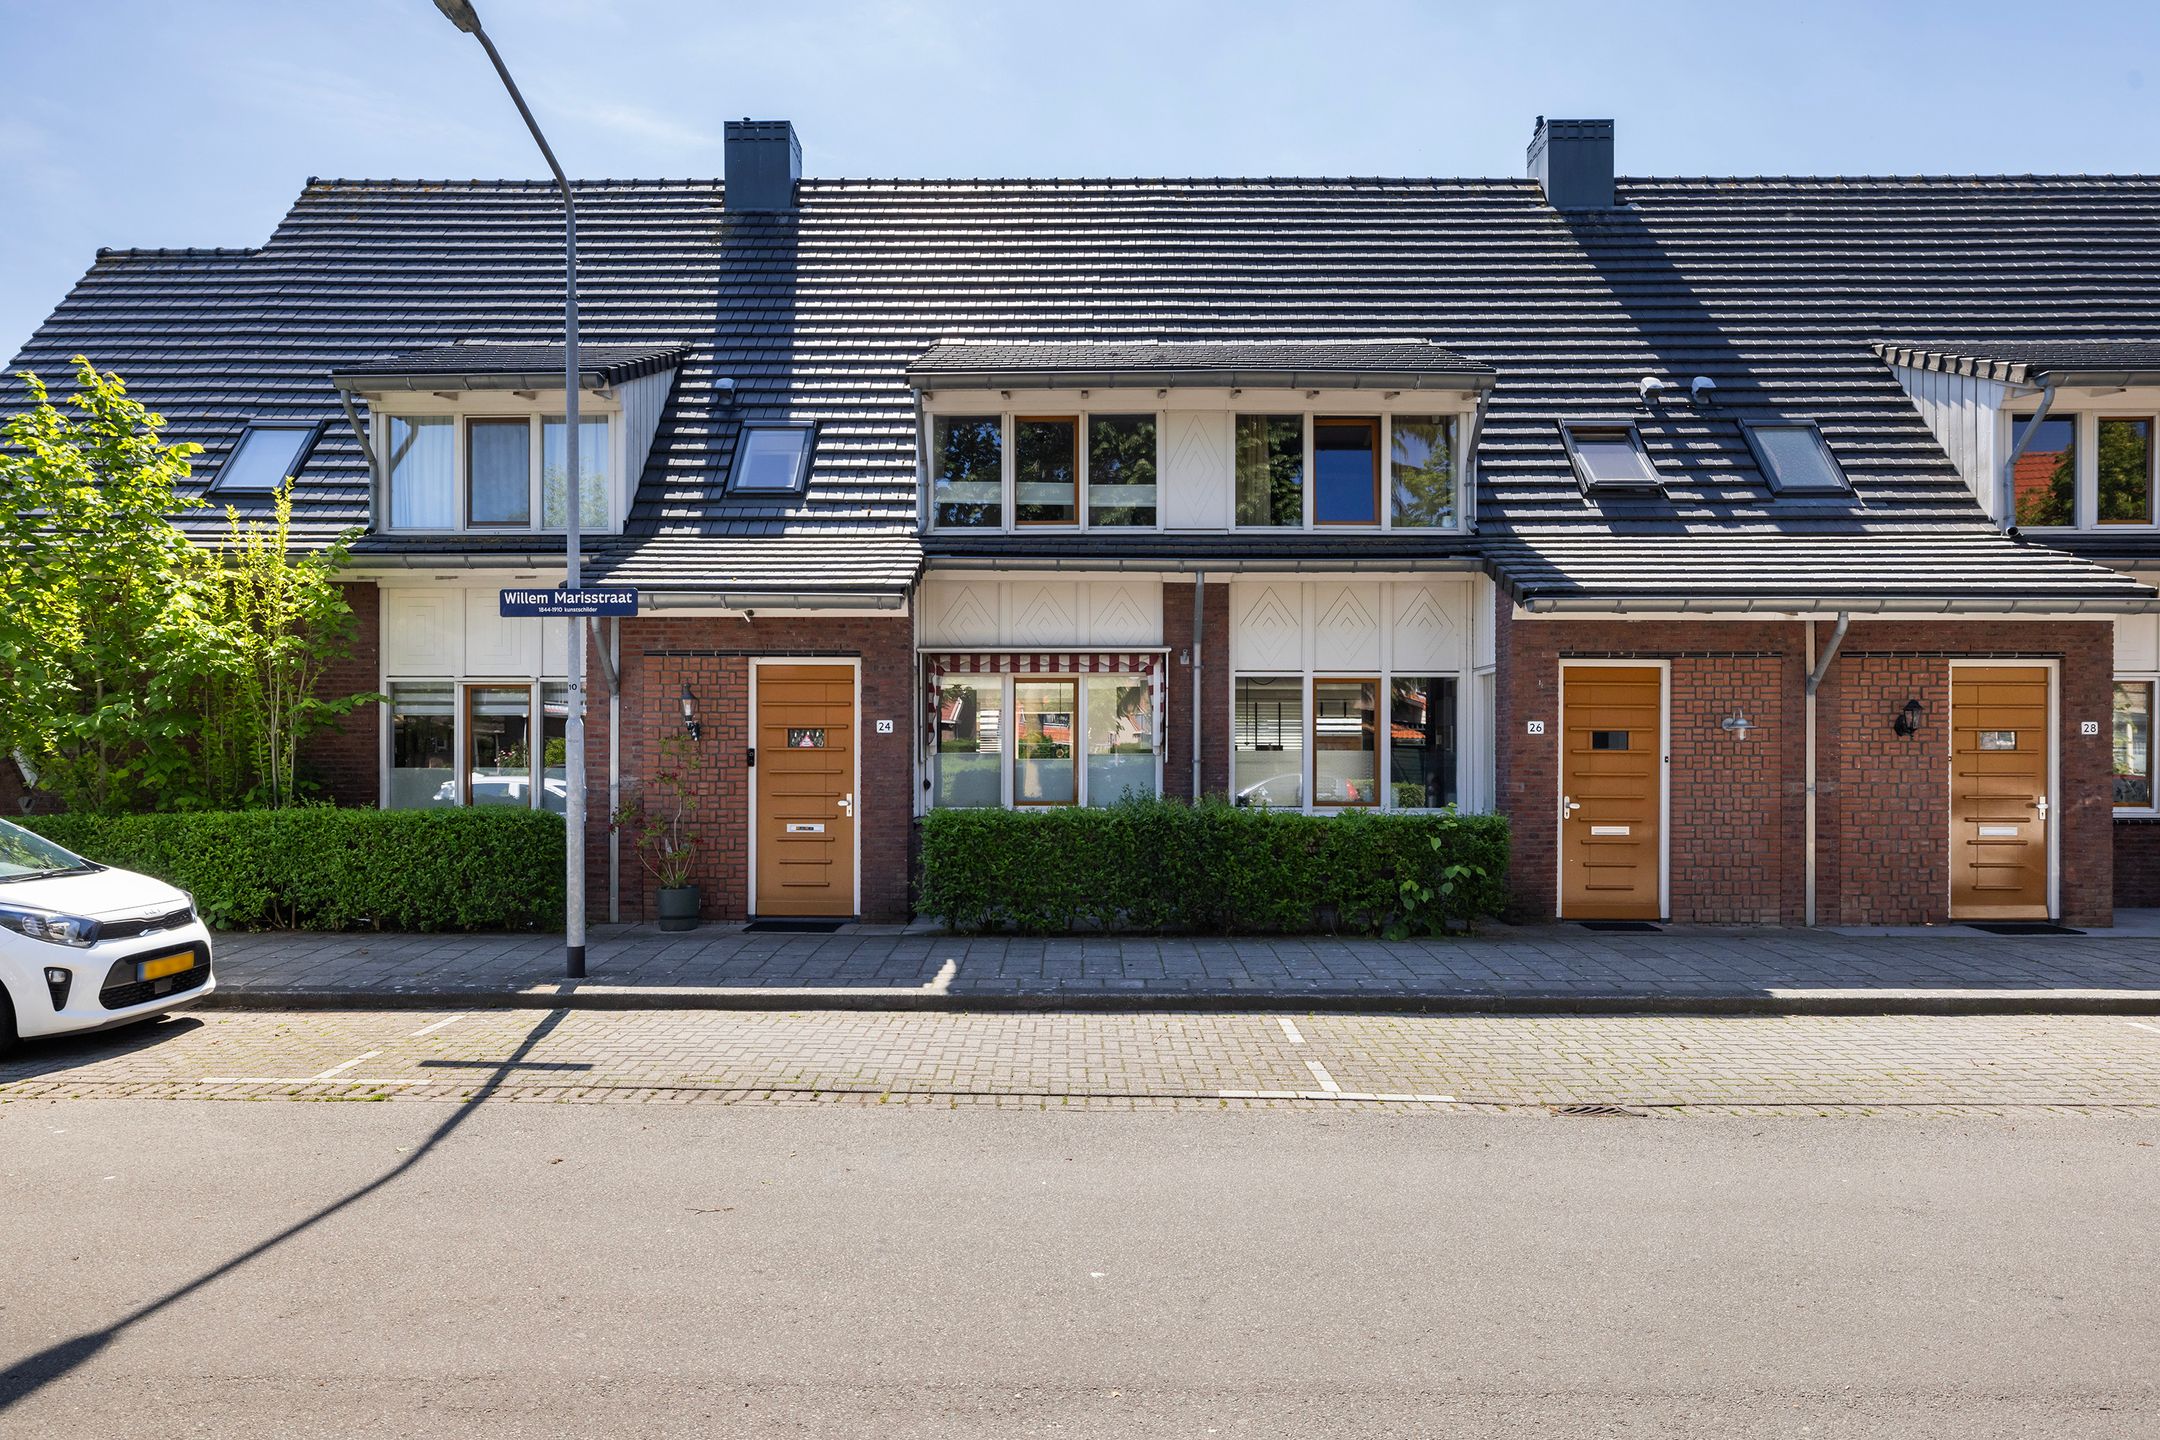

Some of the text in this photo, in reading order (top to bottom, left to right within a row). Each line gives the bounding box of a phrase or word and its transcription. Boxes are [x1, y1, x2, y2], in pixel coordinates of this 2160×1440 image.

[504, 591, 632, 604] Willem Marisstraat
[568, 683, 578, 691] 10
[878, 722, 891, 731] 24
[1529, 723, 1542, 732] 26
[2084, 723, 2097, 733] 28
